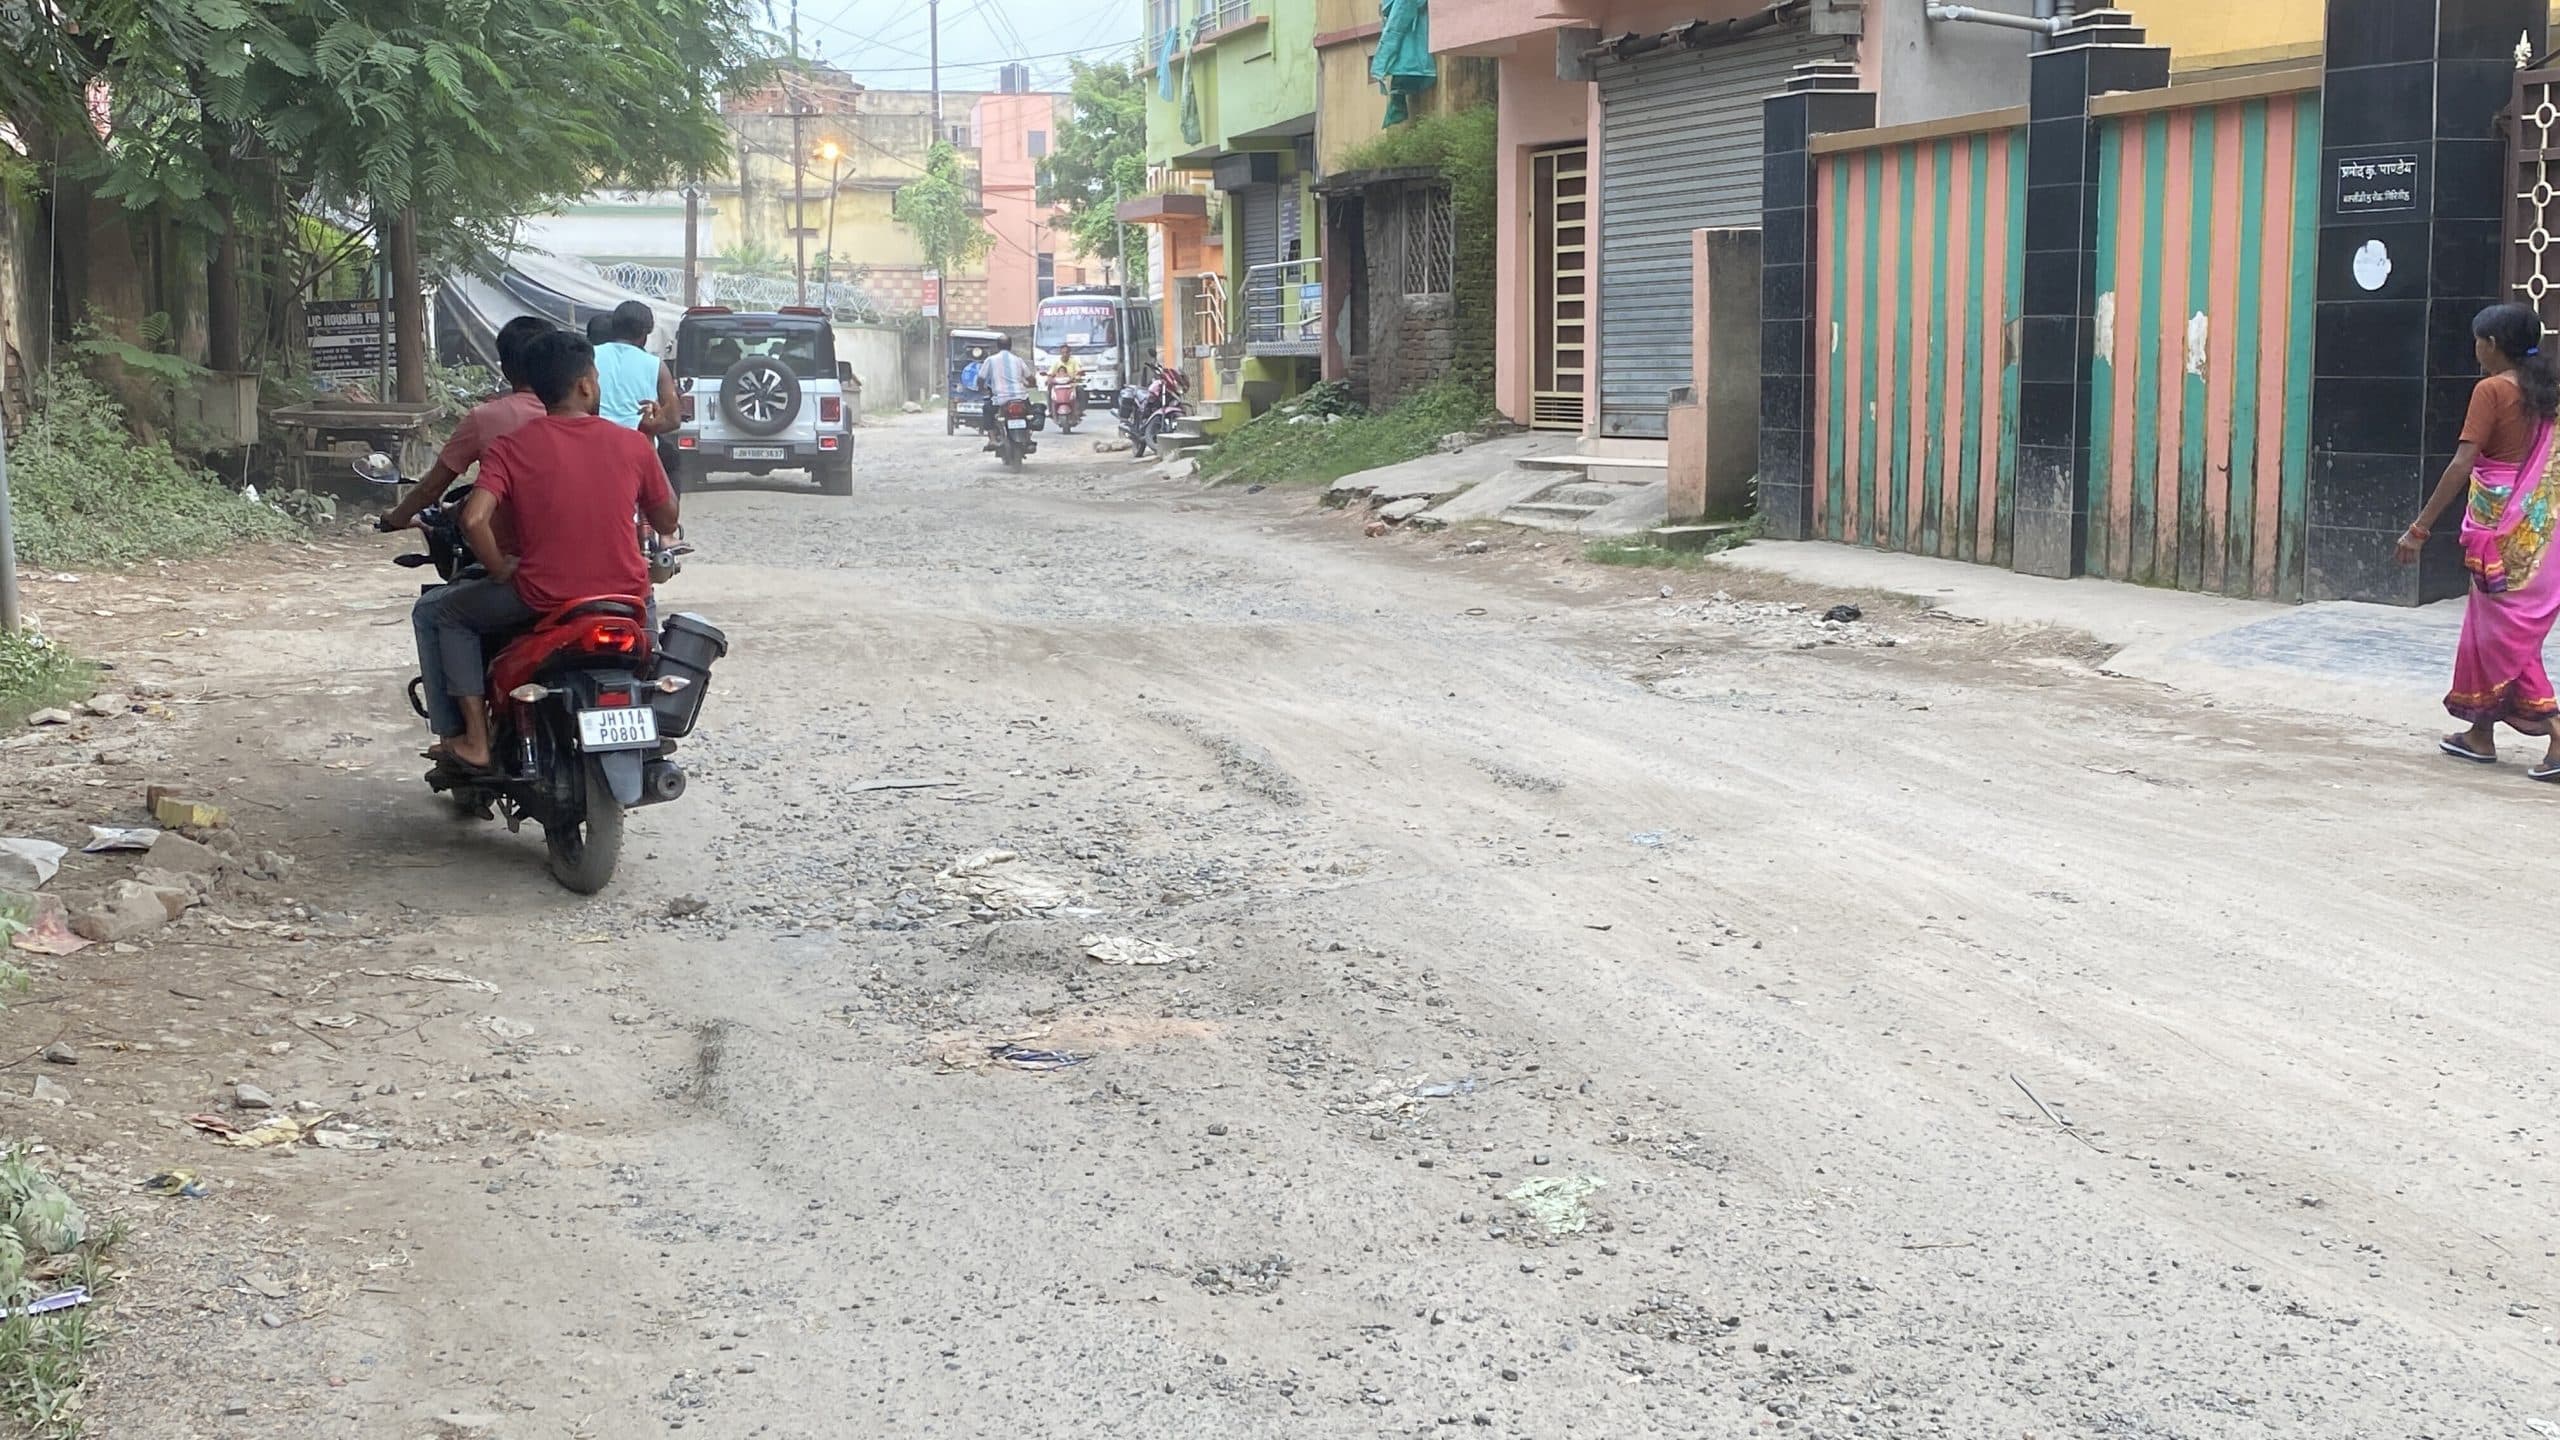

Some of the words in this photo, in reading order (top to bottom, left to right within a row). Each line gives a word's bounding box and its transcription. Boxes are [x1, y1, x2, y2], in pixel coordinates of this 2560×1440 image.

[2377, 158, 2416, 175] पाण्डेय
[323, 313, 364, 327] HOUSING
[599, 710, 645, 727] JH11A
[600, 726, 647, 744] P0801
